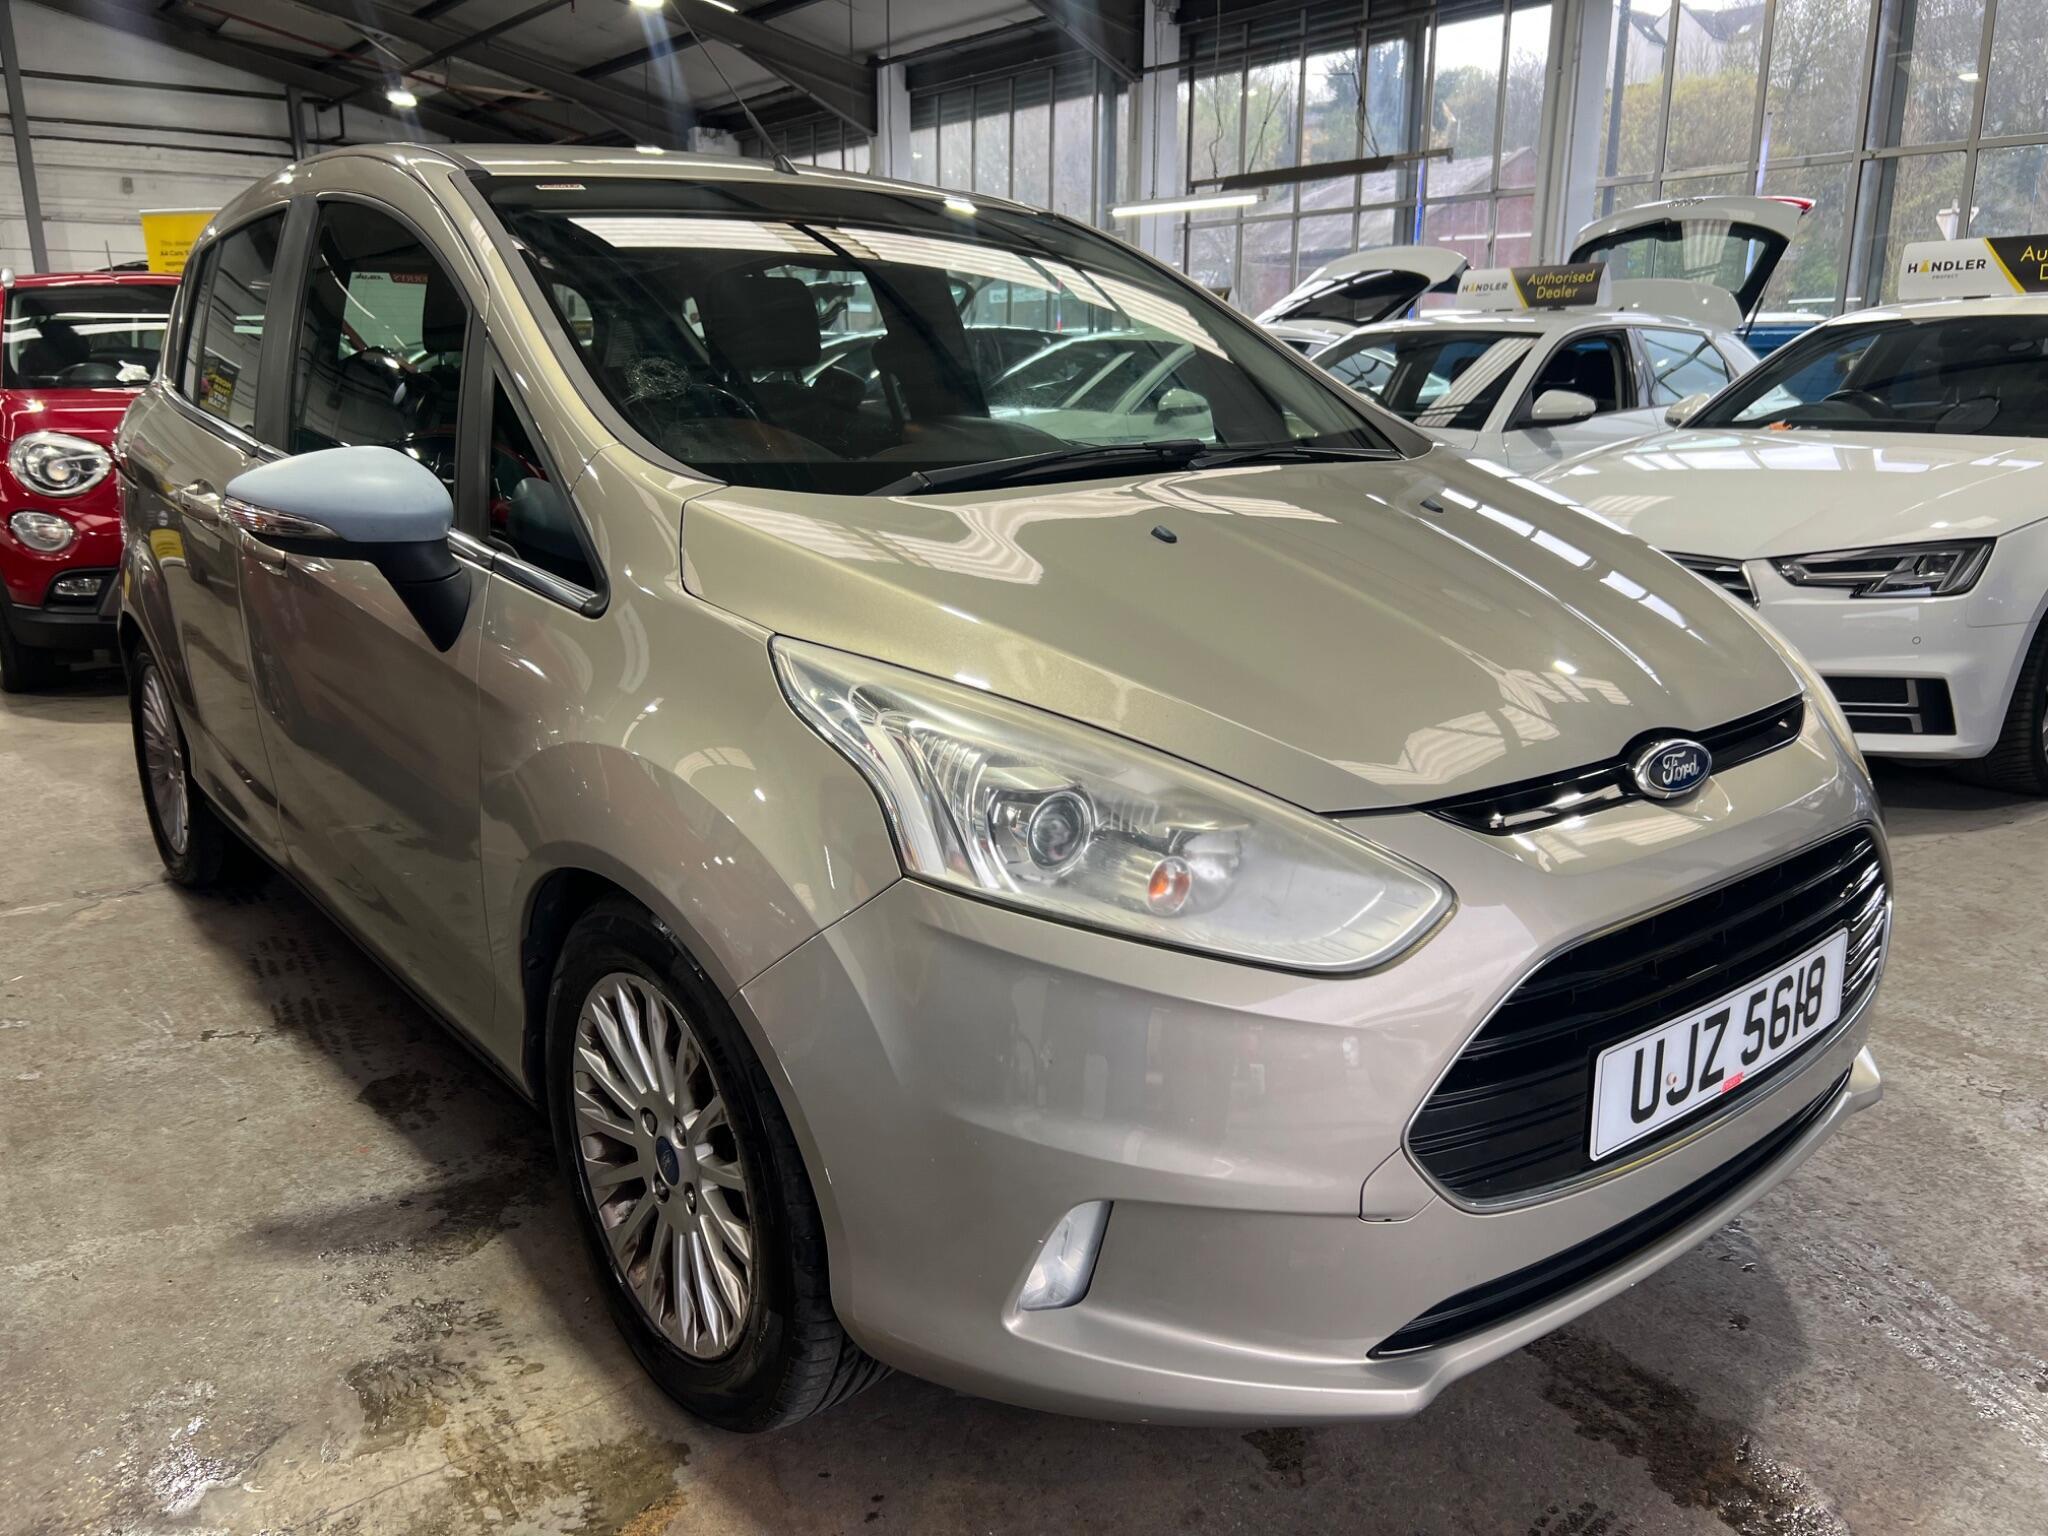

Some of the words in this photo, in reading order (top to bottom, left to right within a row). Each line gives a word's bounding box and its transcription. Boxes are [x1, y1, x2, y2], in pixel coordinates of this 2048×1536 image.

[1907, 258, 1987, 274] HANDLER
[1526, 269, 1596, 286] Authorised
[1462, 281, 1509, 293] HANDLER
[1535, 285, 1579, 300] Dealer
[1662, 750, 1700, 785] Ford
[1630, 1006, 1731, 1124] UJZ
[1740, 955, 1826, 1066] 5618
